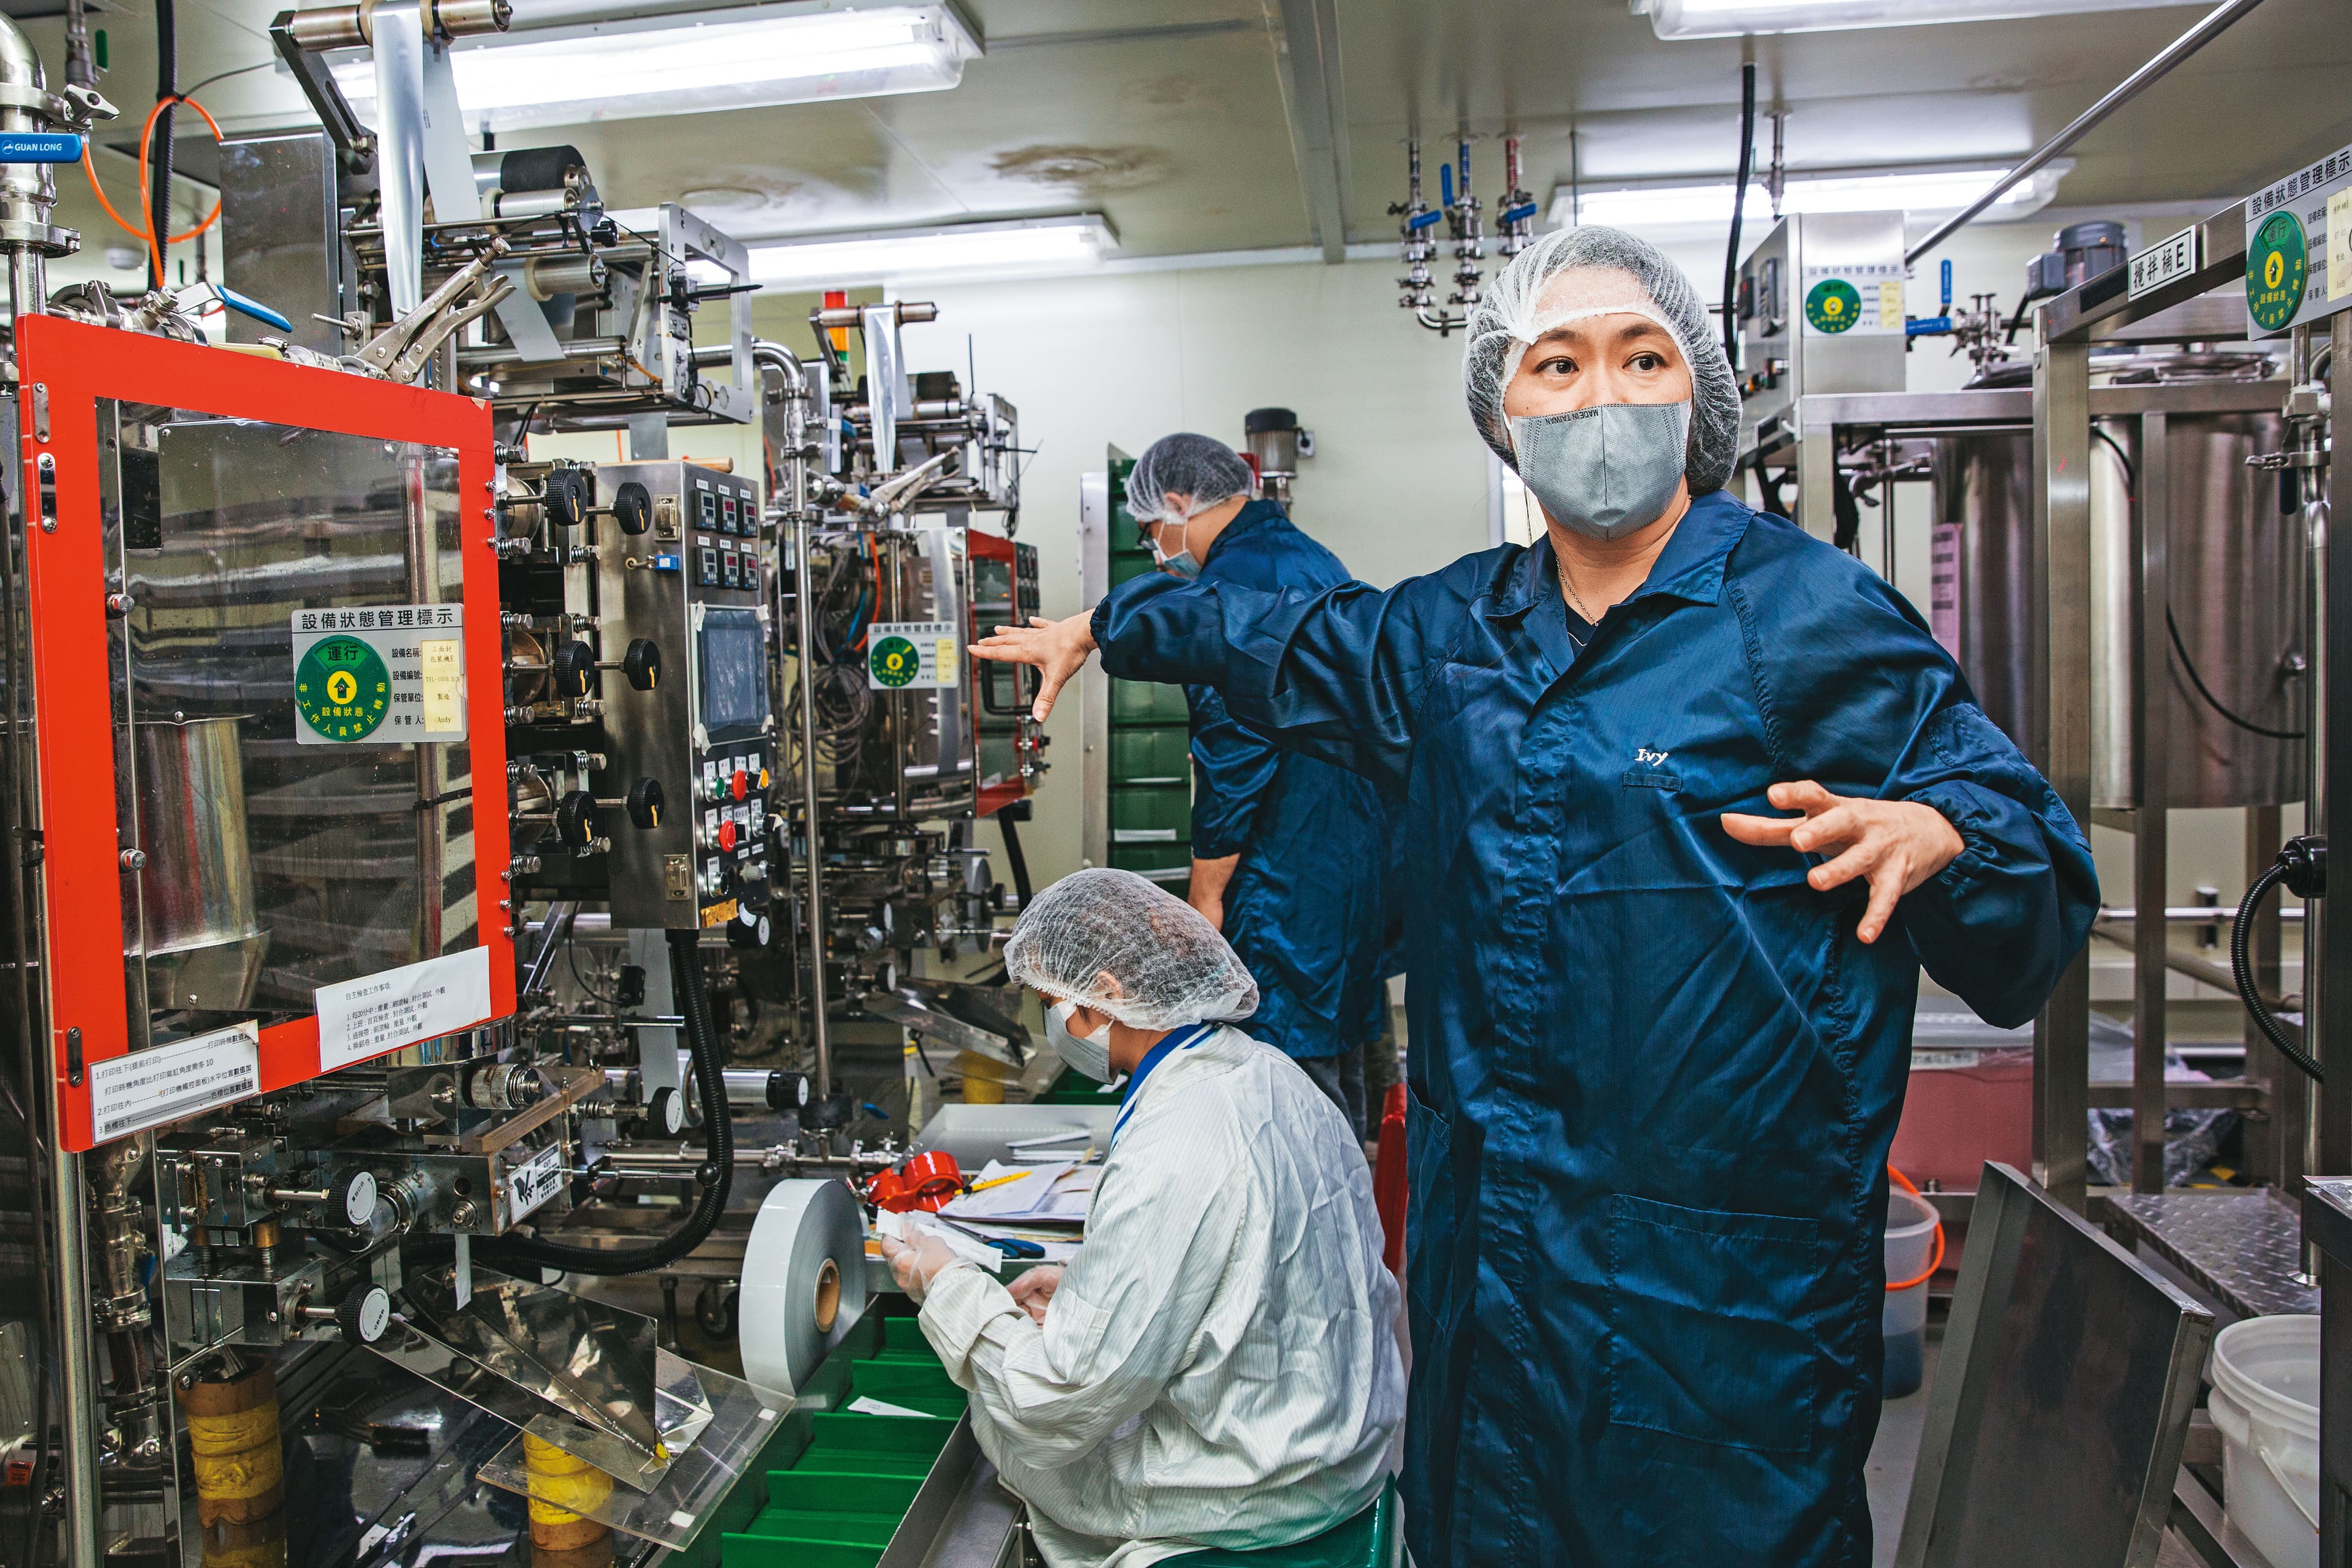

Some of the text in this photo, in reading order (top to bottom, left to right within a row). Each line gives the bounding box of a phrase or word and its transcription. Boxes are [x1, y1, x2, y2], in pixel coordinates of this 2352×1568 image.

[2252, 151, 2350, 216] 設備狀態管理標示
[2267, 220, 2286, 243] 運行
[2134, 242, 2184, 289] 攪拌桶E
[302, 608, 453, 630] 設備狀態管理標示
[328, 645, 358, 661] 運行
[322, 706, 363, 717] 設備狀態
[1634, 748, 1669, 766] Ivy
[206, 1058, 214, 1067] 10
